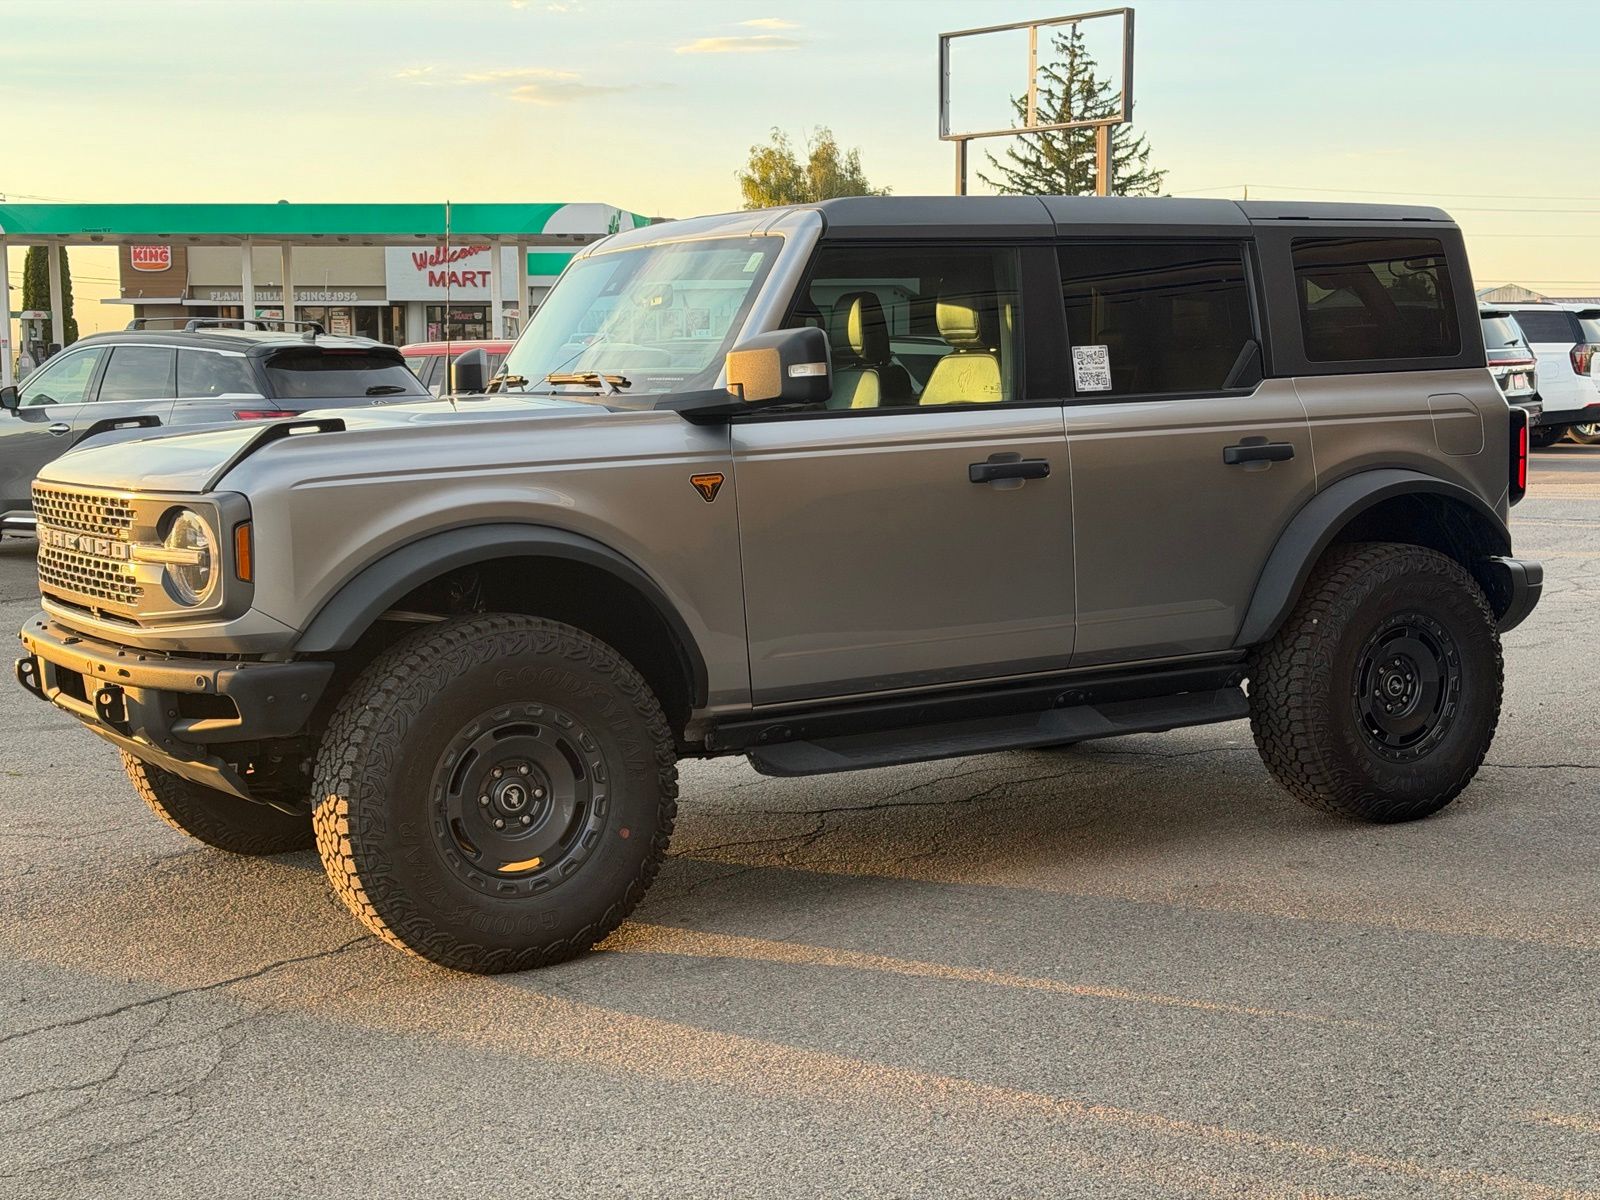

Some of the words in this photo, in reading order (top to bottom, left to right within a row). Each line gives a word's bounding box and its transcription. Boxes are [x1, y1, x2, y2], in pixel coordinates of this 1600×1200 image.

[132, 250, 169, 262] KING
[428, 271, 491, 287] MART
[300, 291, 332, 301] SINCE
[42, 528, 129, 560] BRONCO
